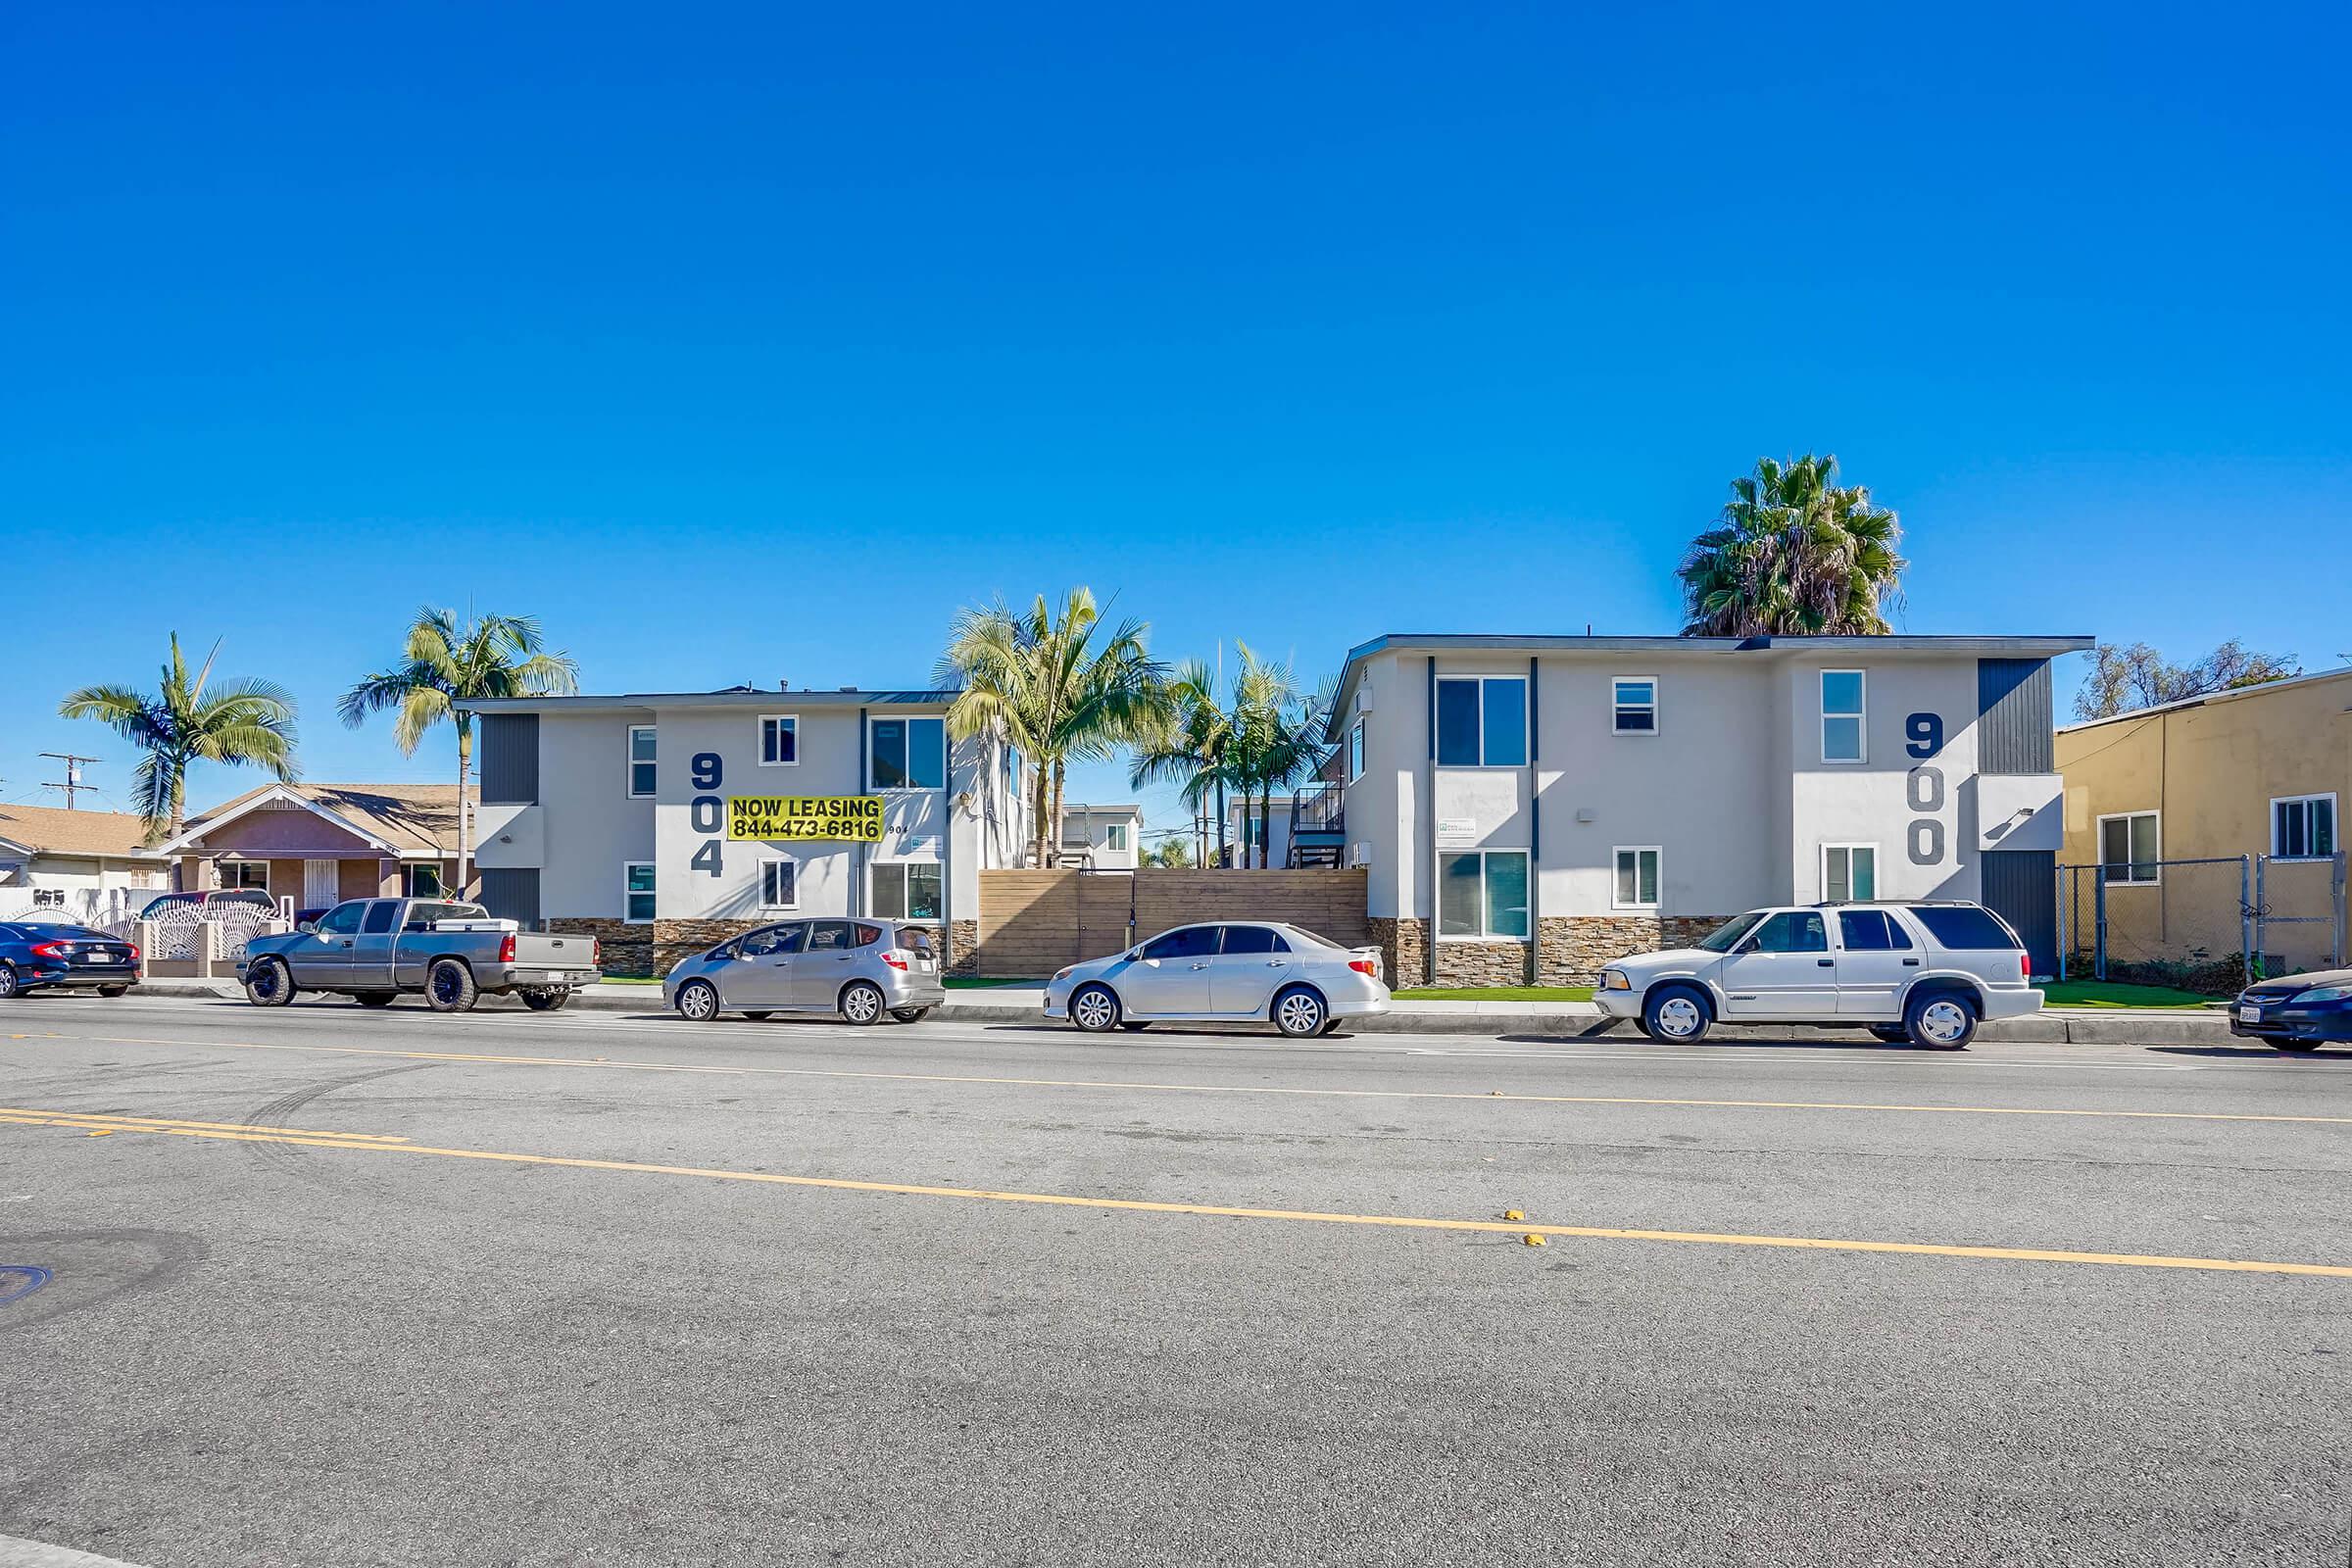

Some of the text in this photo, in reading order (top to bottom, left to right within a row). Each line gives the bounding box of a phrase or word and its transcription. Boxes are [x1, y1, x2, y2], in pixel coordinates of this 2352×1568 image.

[691, 753, 722, 878] 904
[733, 799, 879, 818] NOW LEASING
[1905, 712, 1945, 865] 900
[733, 820, 879, 838] 844-473-6816
